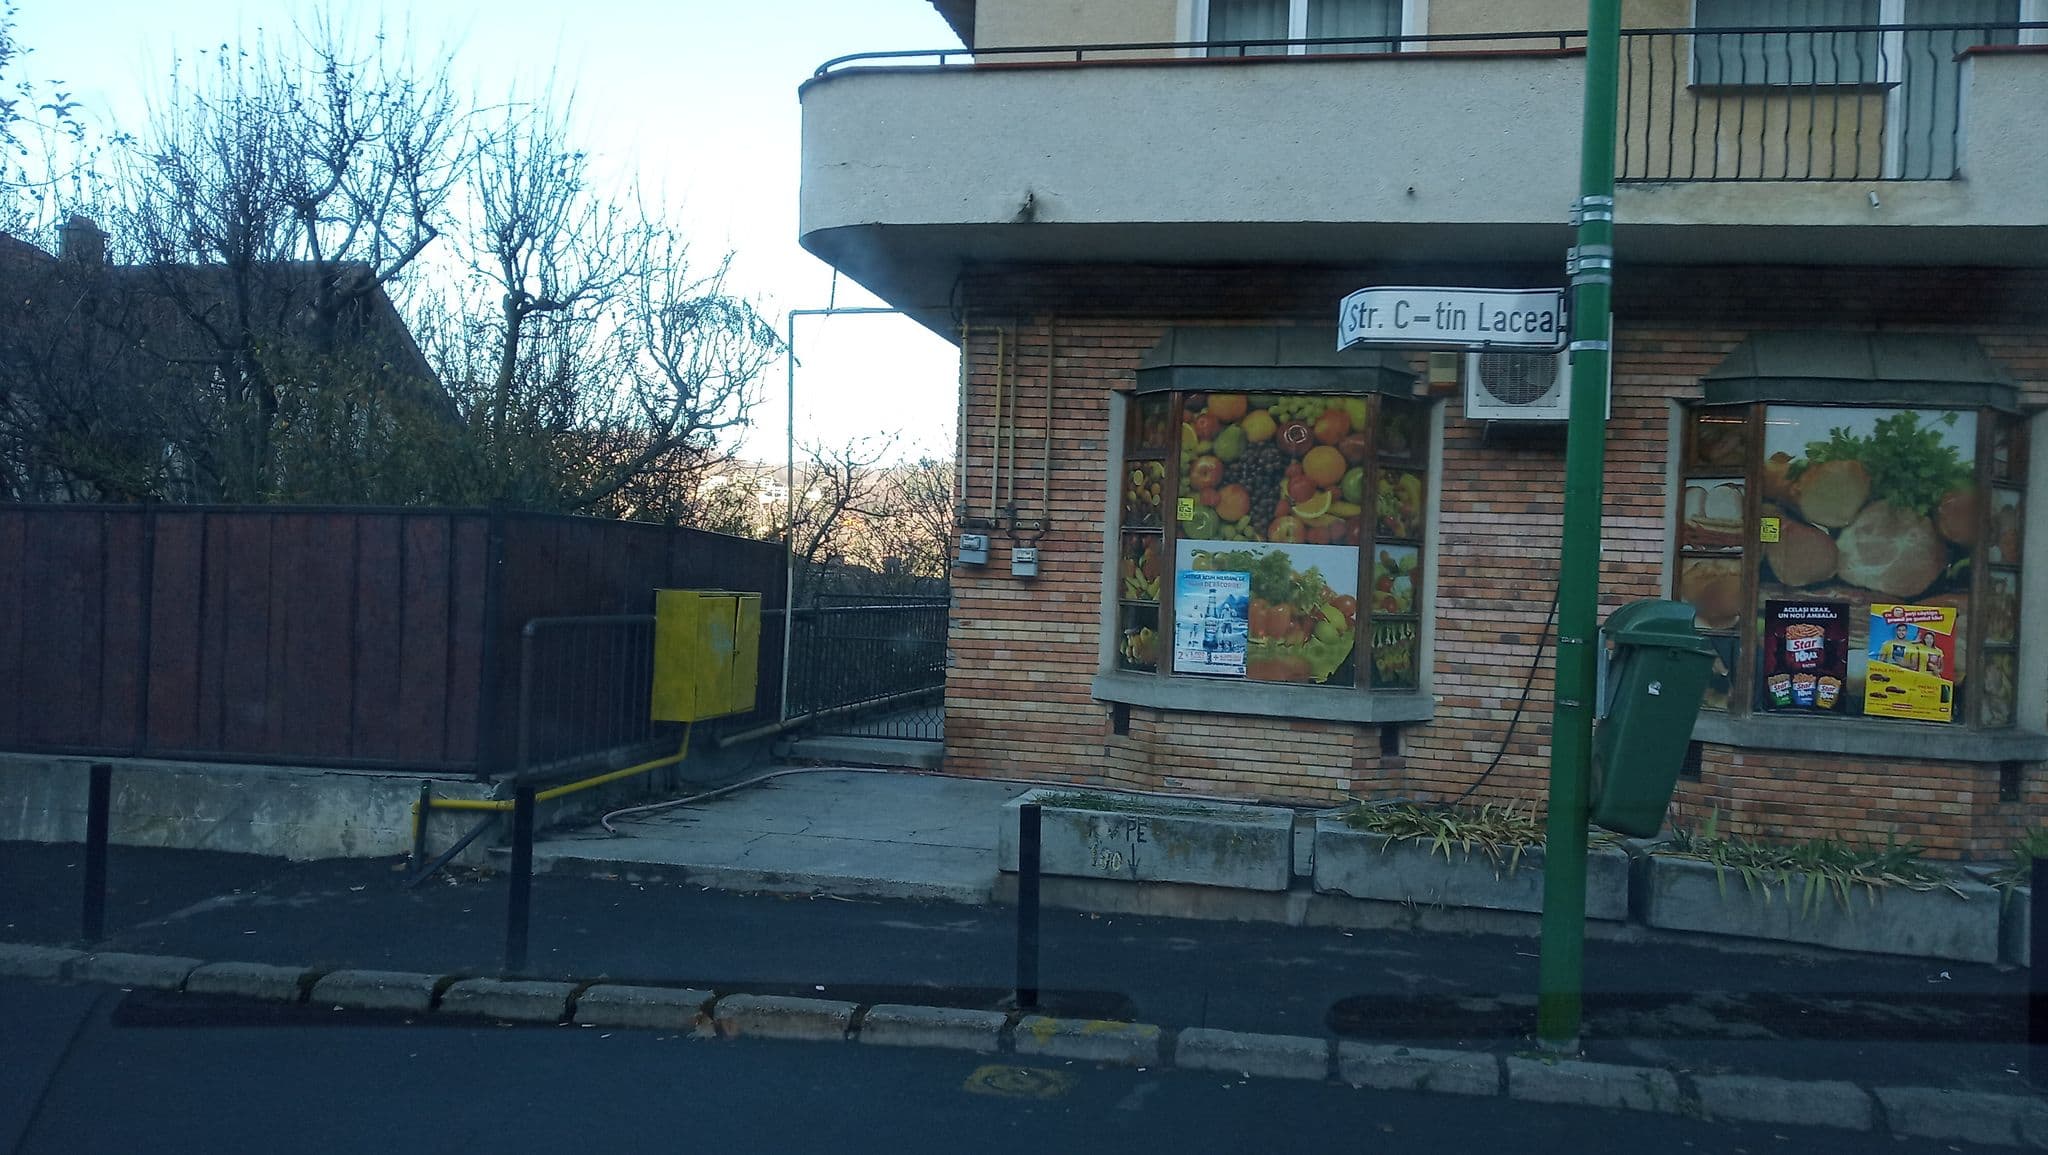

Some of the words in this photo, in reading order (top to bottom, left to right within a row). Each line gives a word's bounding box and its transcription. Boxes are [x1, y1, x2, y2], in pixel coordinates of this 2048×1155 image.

[1348, 302, 1384, 332] Str.
[1394, 300, 1466, 332] C-tin
[1478, 302, 1553, 333] Lacea
[1793, 640, 1817, 650] Star
[1177, 652, 1184, 660] 2
